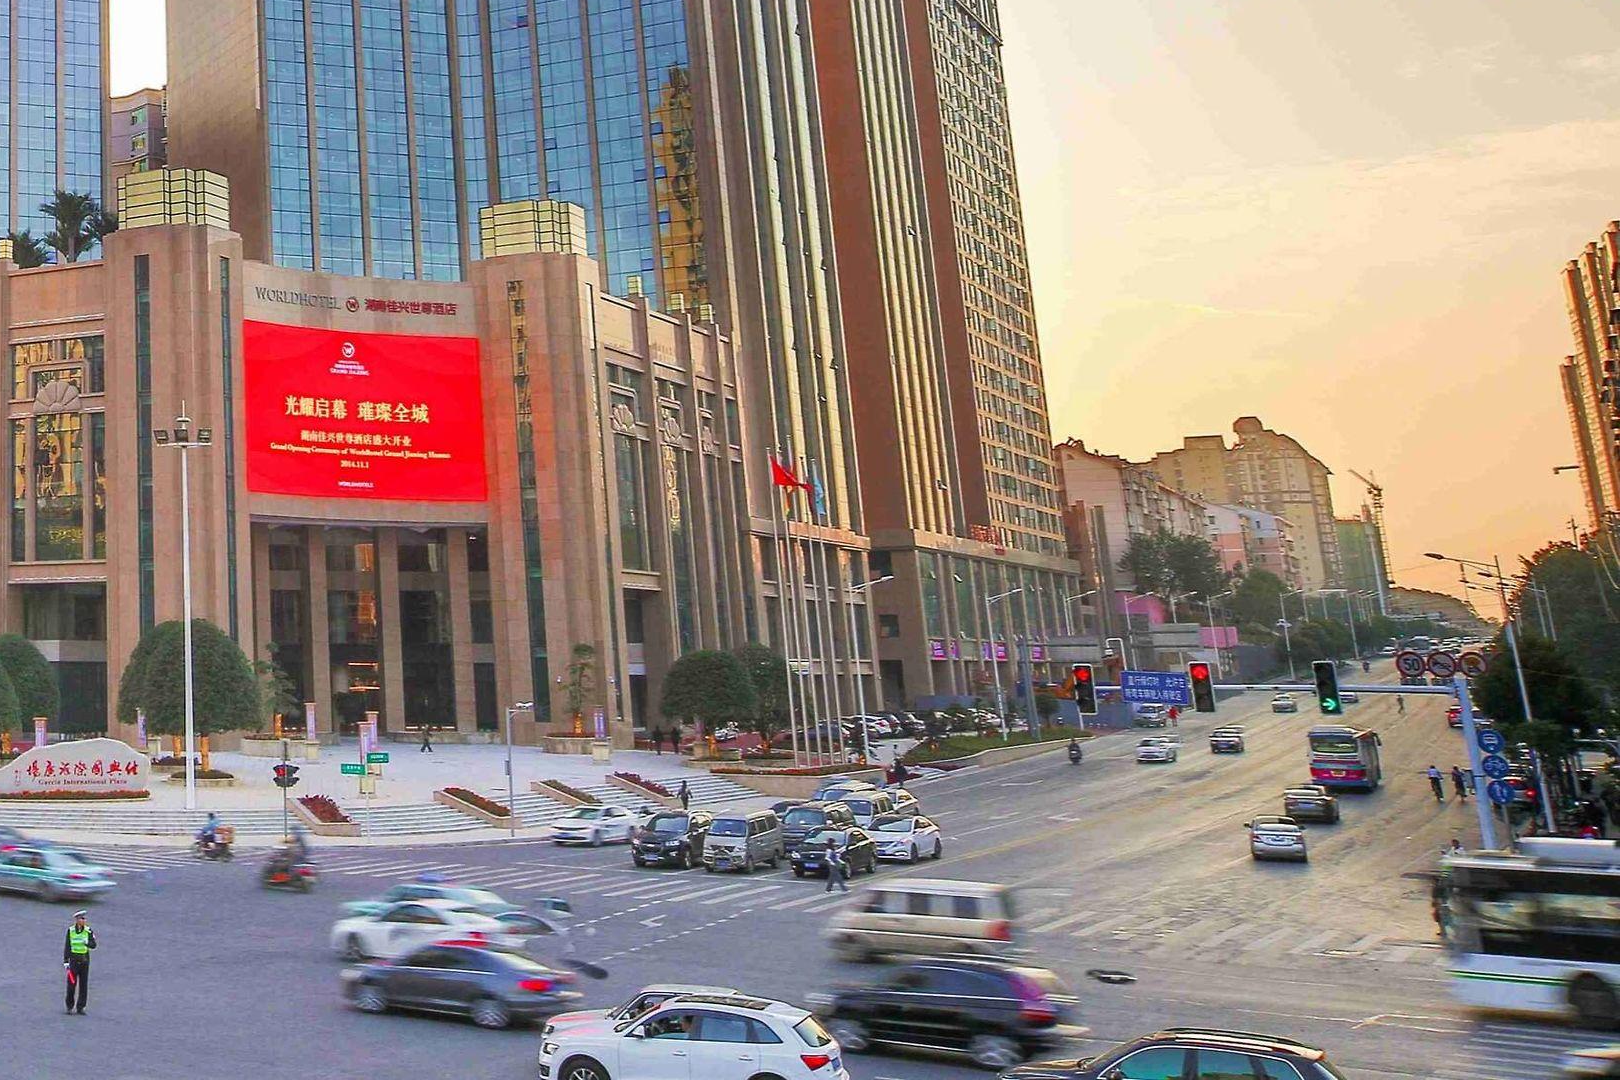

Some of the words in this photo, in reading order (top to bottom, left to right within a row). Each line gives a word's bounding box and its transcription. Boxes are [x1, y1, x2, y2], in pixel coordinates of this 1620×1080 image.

[255, 286, 341, 310] WORLDHOTEL
[285, 395, 347, 419] 光耀启幕
[357, 401, 429, 423] 璀璨全城
[1404, 657, 1421, 671] 50
